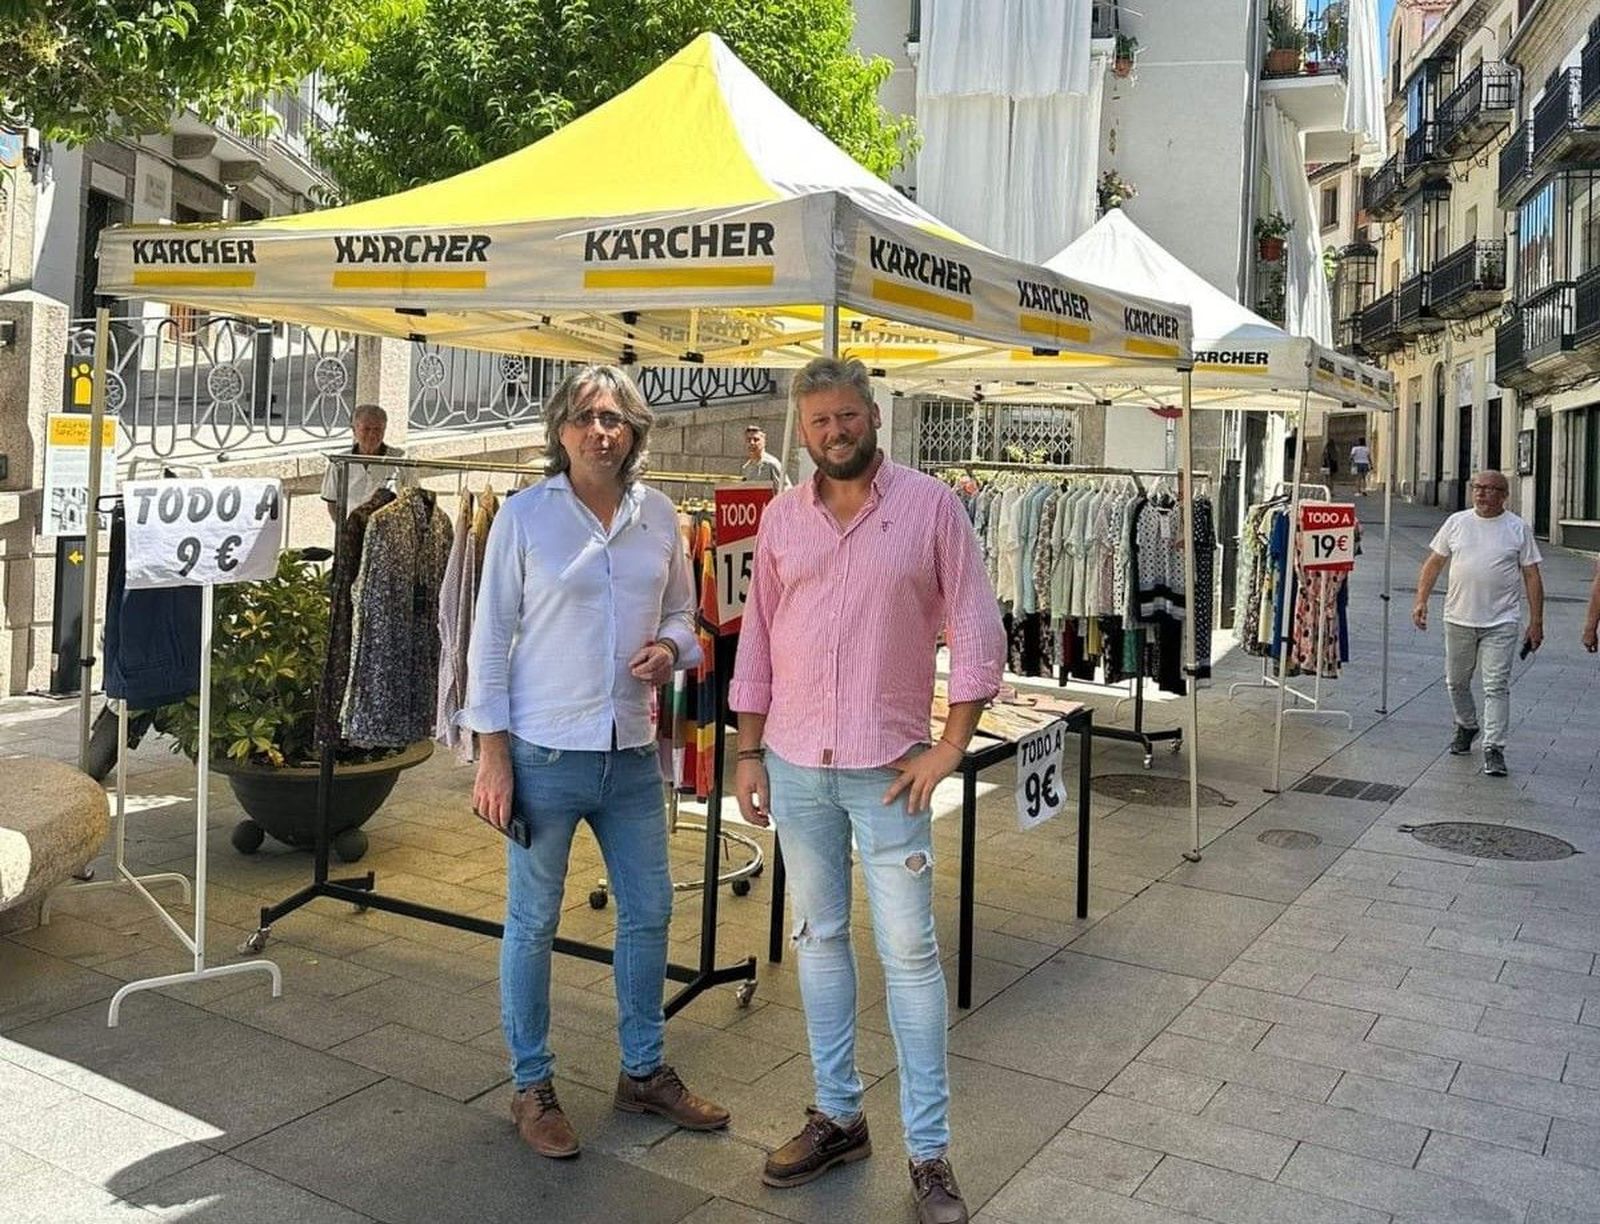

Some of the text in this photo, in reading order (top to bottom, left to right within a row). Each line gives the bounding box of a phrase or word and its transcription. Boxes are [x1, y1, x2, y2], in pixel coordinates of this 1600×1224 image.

[133, 239, 257, 264] KÄRCHER
[334, 235, 492, 263] KÄRCHER
[584, 222, 775, 261] KÄRCHER
[870, 236, 972, 295] KÄRCHER
[1017, 280, 1092, 321] KÄRCHER
[1124, 307, 1179, 340] KÄRCHER
[1194, 351, 1269, 365] ÄRCHER
[133, 484, 278, 525] TODO A
[720, 502, 757, 526] TODO
[1307, 512, 1351, 524] TODO A
[177, 535, 242, 577] 9 €
[1022, 729, 1062, 767] TODO A
